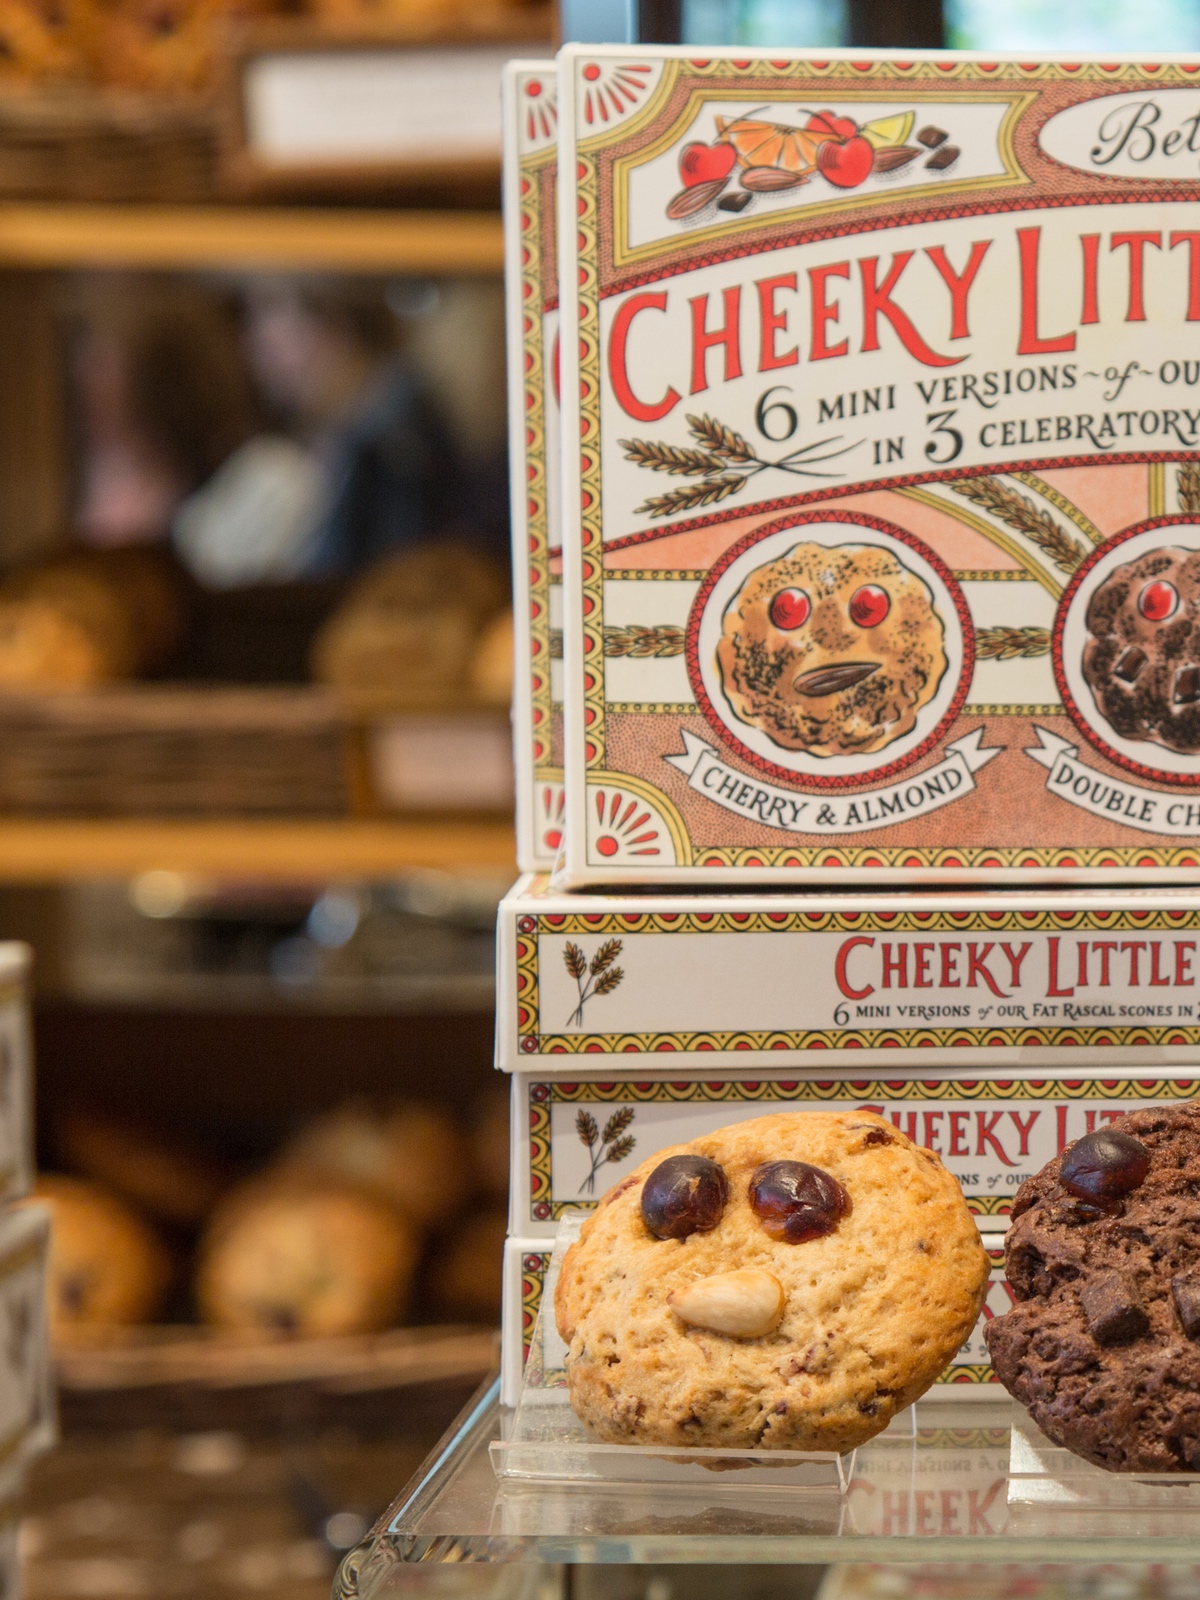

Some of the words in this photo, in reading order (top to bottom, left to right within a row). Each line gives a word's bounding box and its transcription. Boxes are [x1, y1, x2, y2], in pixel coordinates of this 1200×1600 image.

[607, 238, 994, 423] CHEEKY
[754, 385, 799, 443] 6
[816, 384, 896, 425] MINI
[915, 363, 1078, 409] VERSIONS
[872, 436, 905, 465] IN
[924, 408, 965, 464] 3
[701, 766, 809, 827] CHERRY
[815, 804, 839, 826] &
[844, 767, 963, 827] ALMOND
[1053, 763, 1158, 823] DOUBLE
[834, 935, 1034, 1001] CHEEKY
[1045, 936, 1197, 997] LITTLE
[832, 1001, 851, 1026] 6
[855, 1004, 891, 1018] MINI
[896, 1004, 971, 1020] VERSIONS
[997, 1004, 1029, 1021] OUR
[1119, 1004, 1173, 1017] SCONES
[1177, 1005, 1194, 1017] IN
